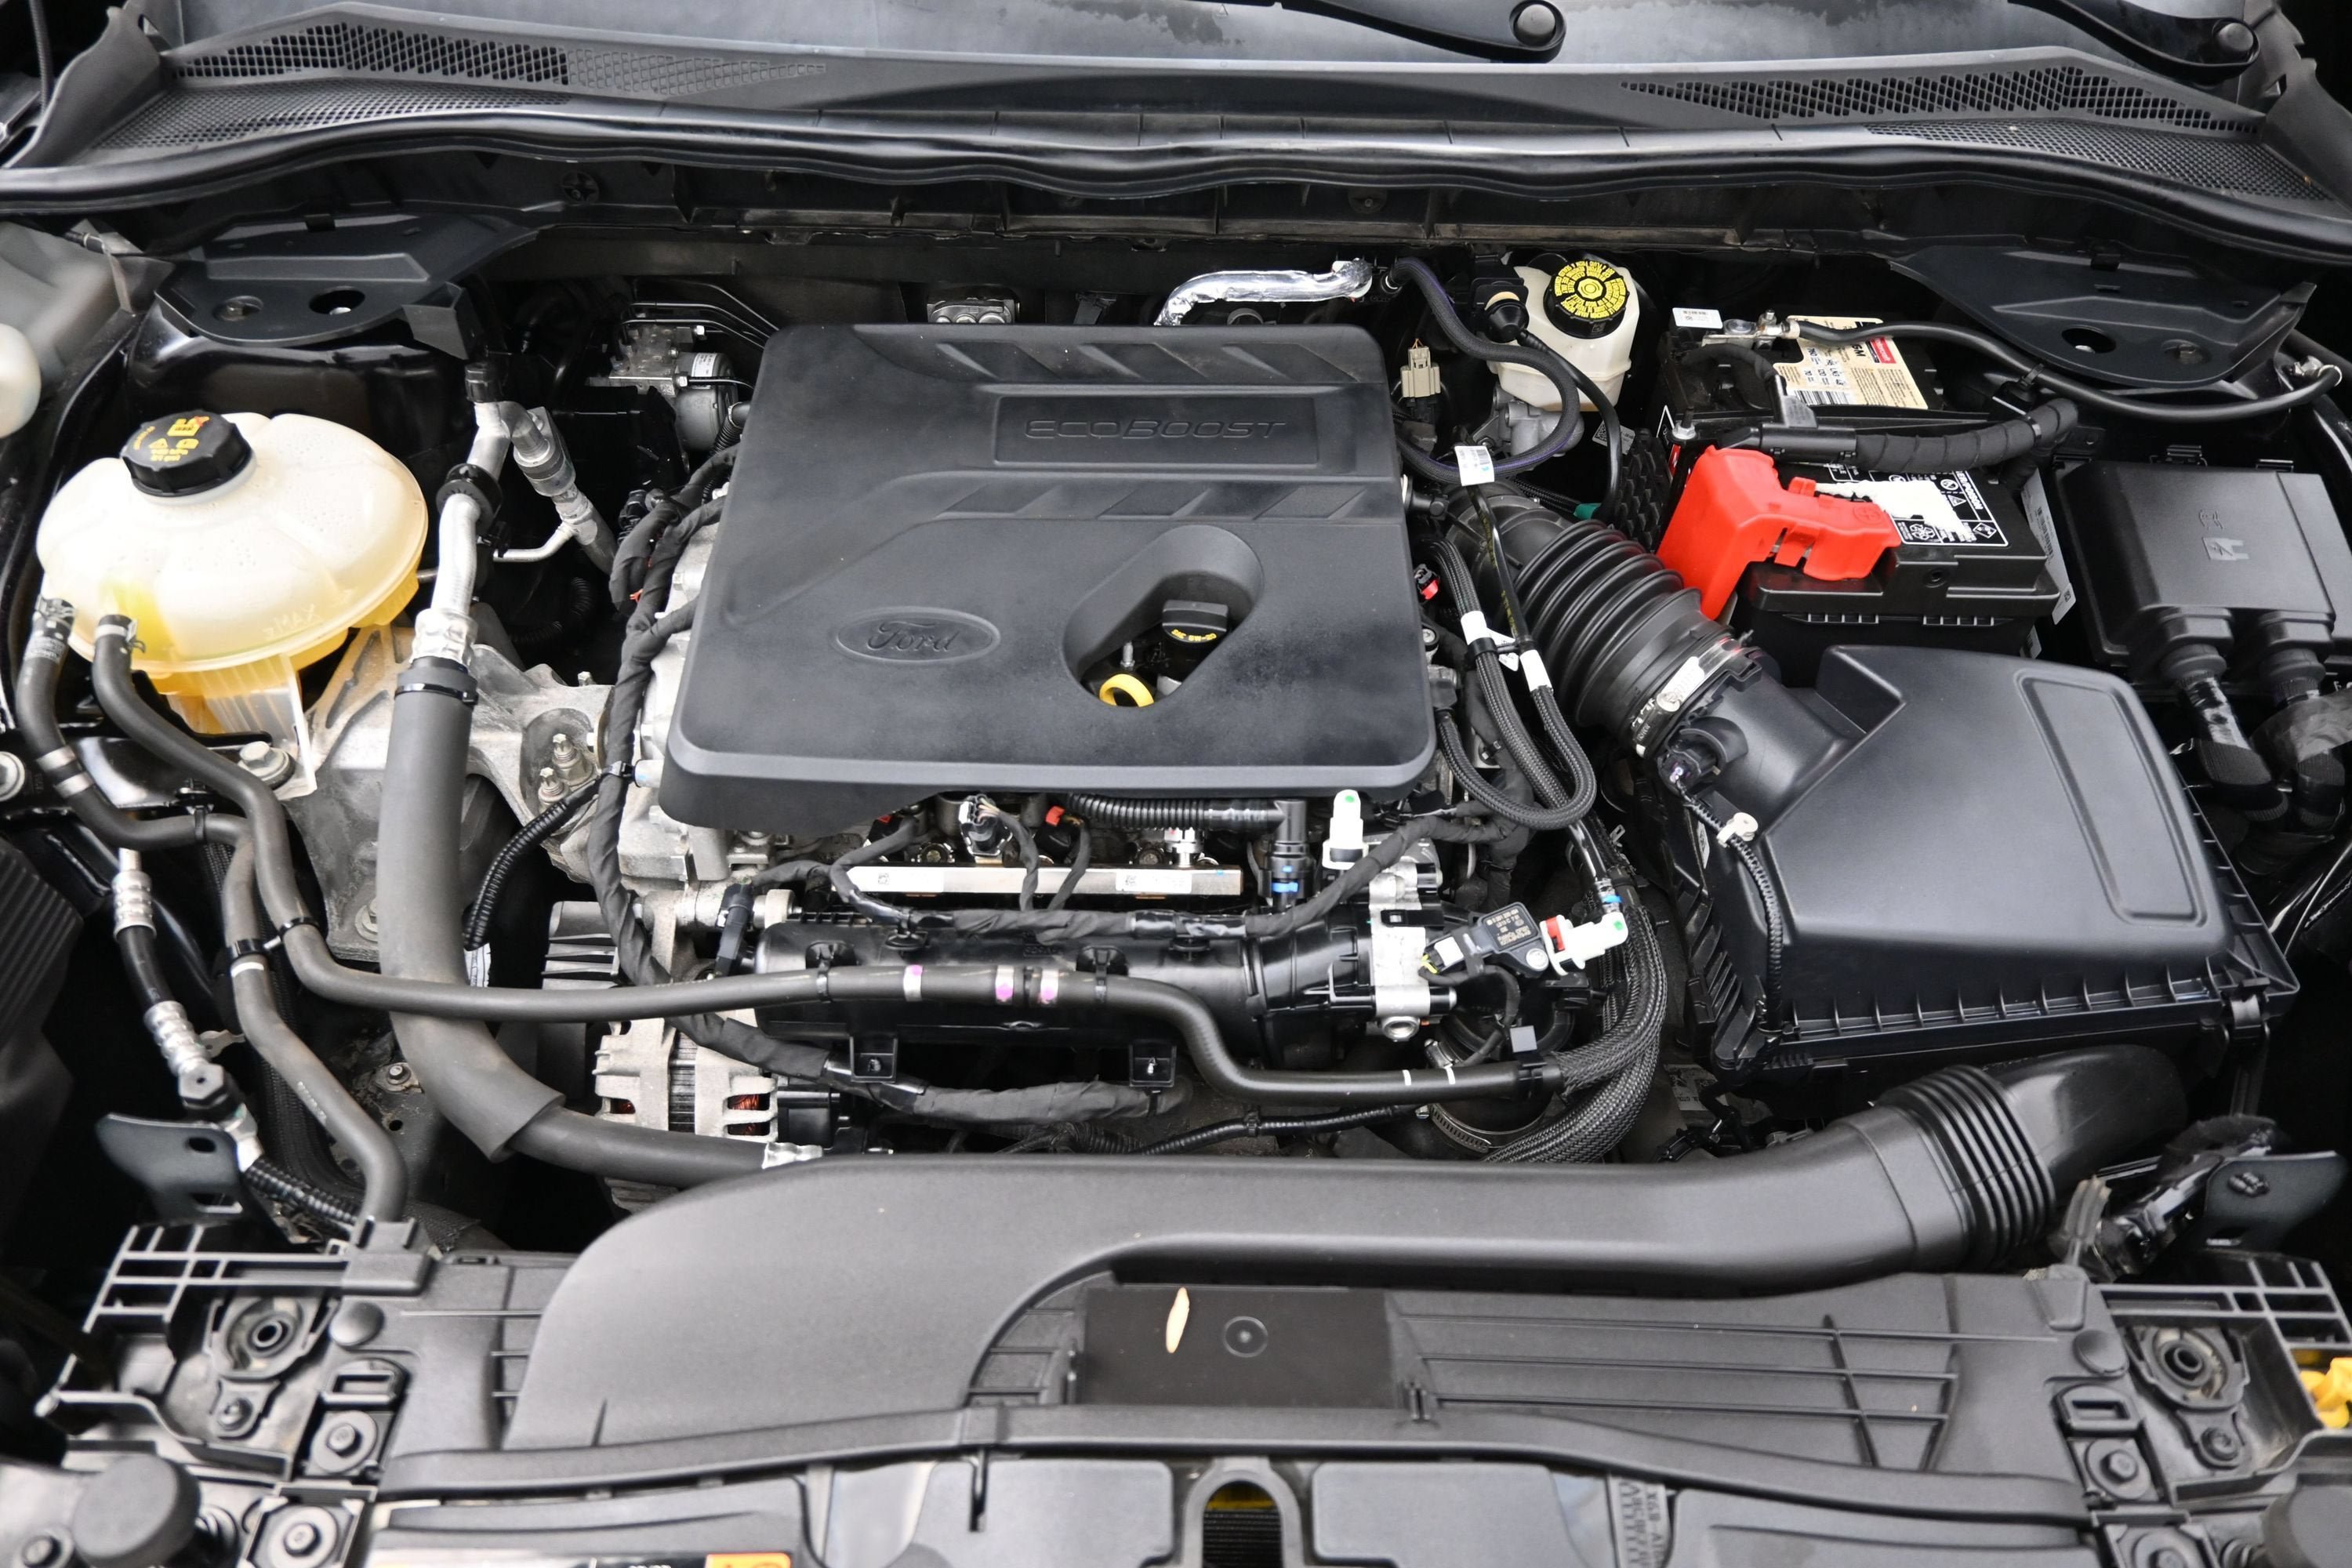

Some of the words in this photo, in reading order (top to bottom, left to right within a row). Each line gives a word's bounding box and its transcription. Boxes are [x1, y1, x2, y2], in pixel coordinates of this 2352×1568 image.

[1025, 419, 1287, 439] ECOBOOST
[867, 621, 960, 652] Ford
[1171, 629, 1187, 639] SAE
[1188, 633, 1217, 642] 5W-20
